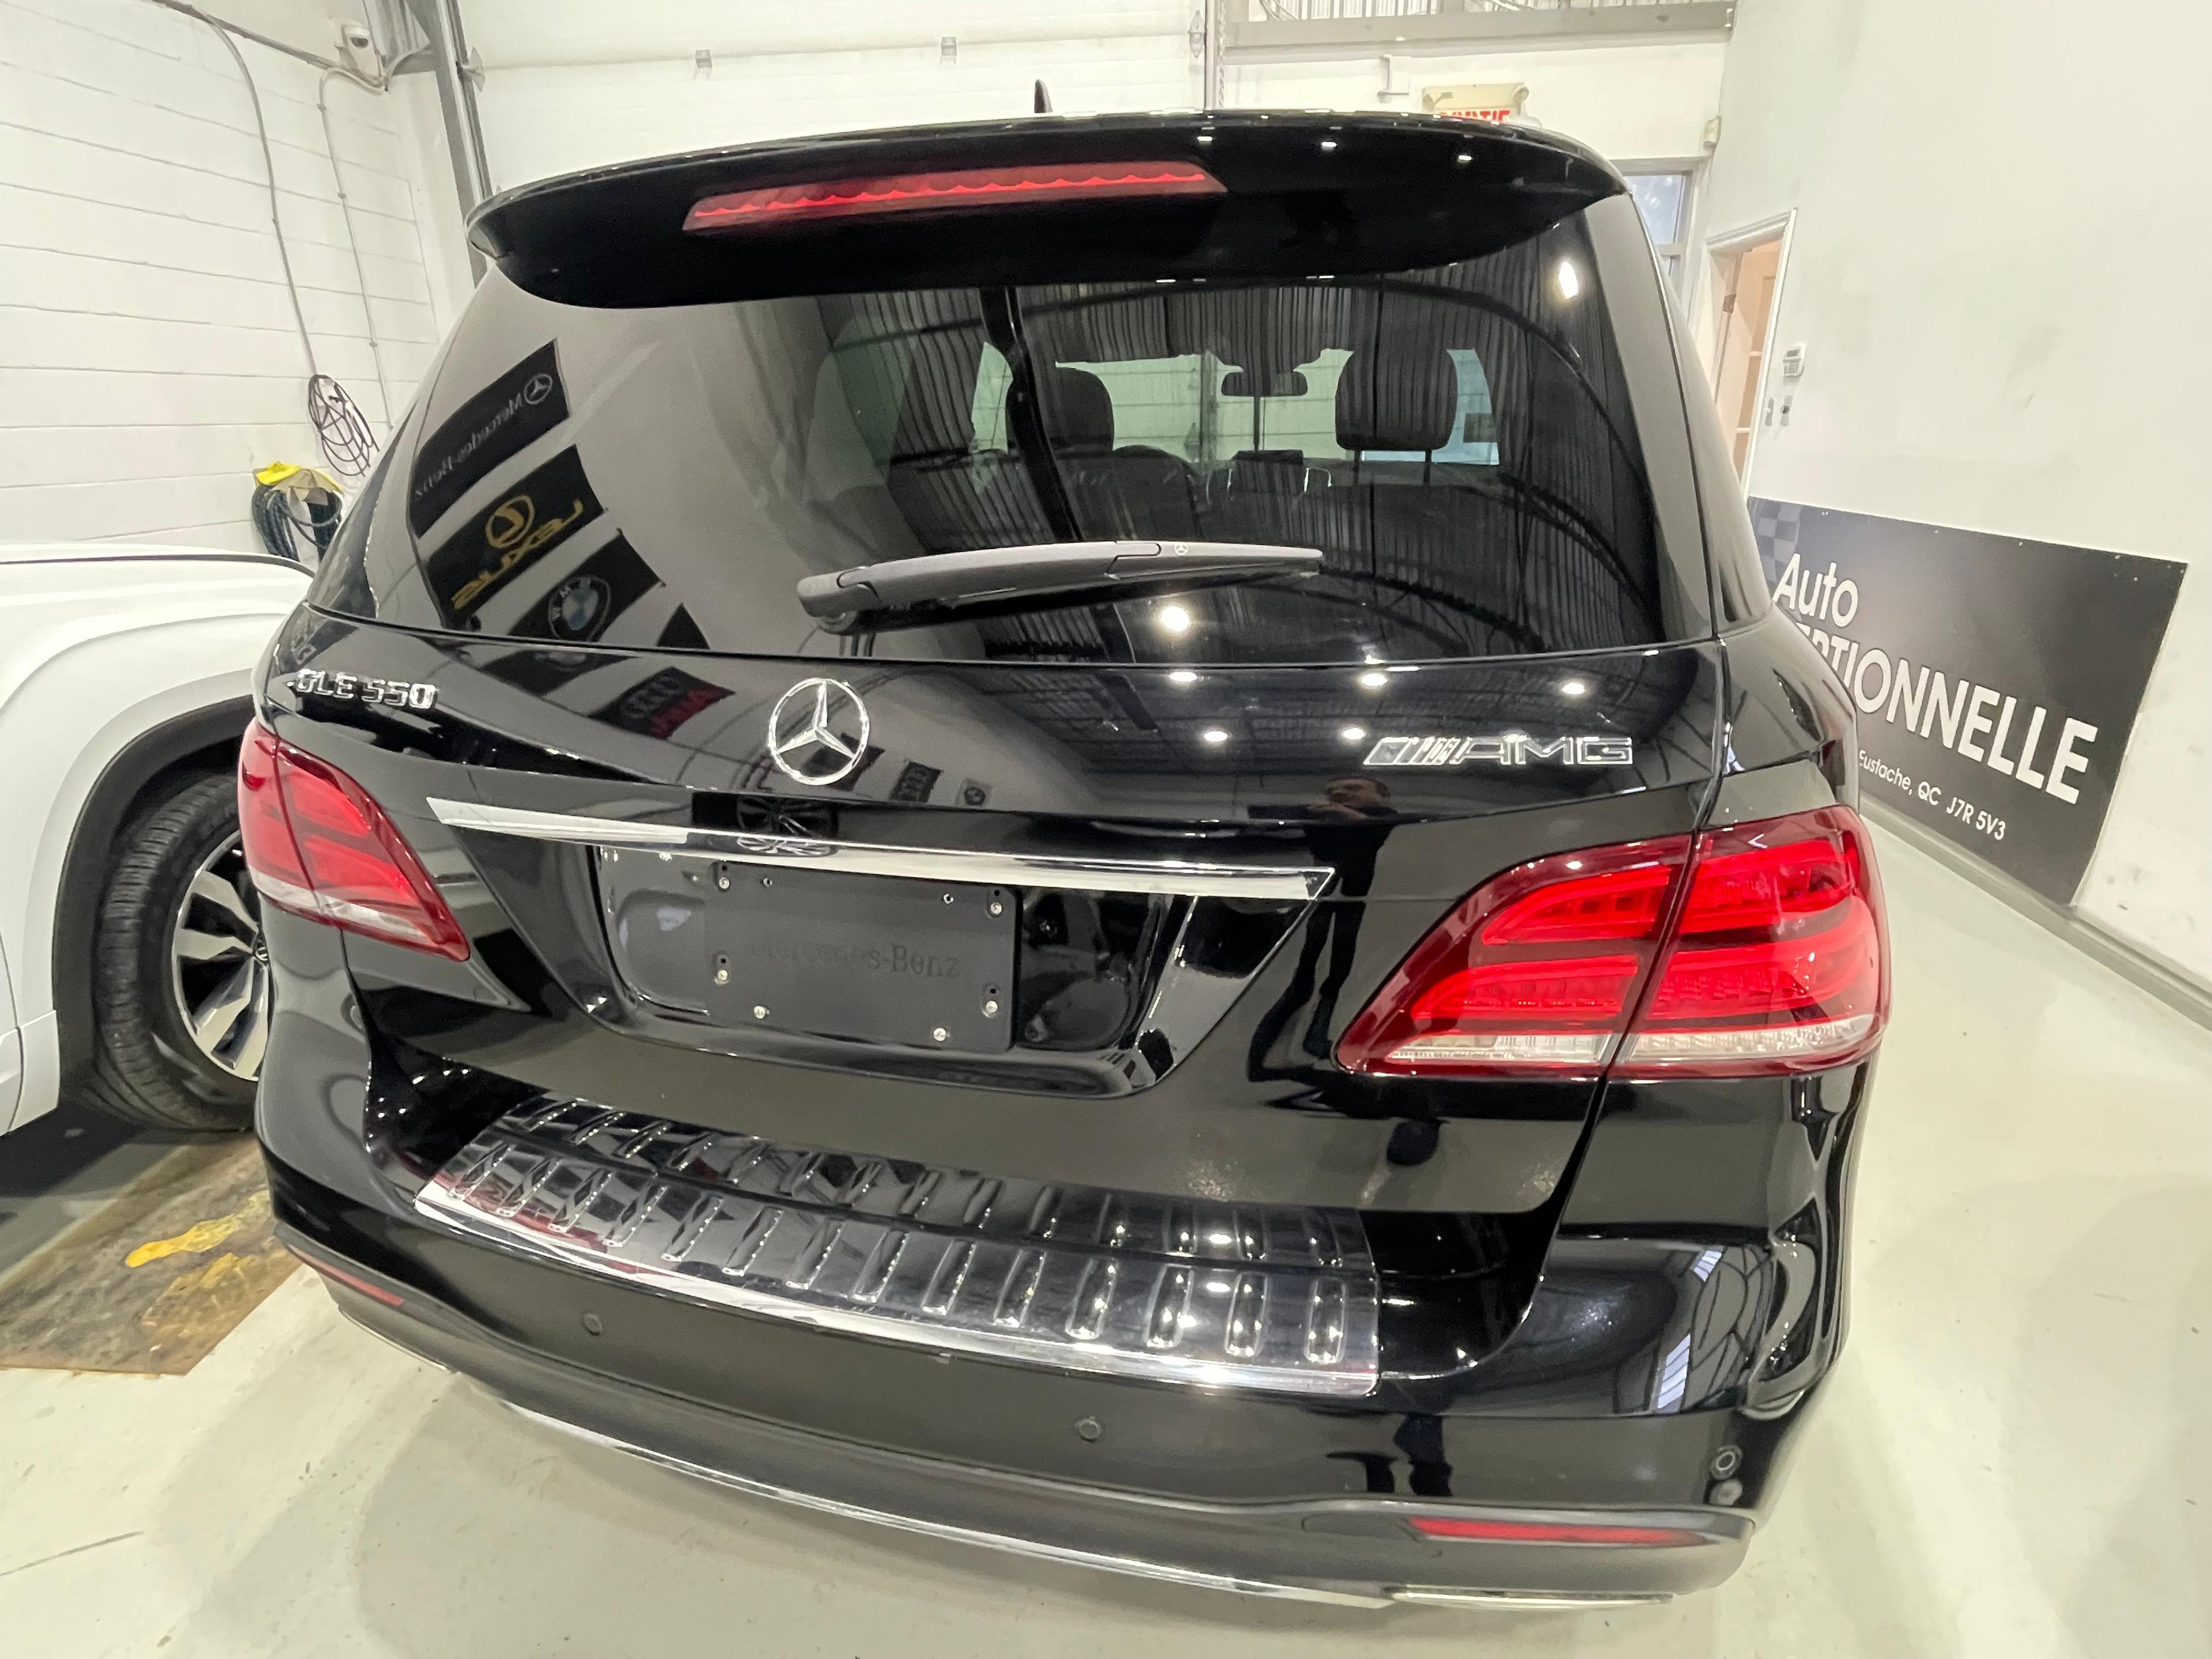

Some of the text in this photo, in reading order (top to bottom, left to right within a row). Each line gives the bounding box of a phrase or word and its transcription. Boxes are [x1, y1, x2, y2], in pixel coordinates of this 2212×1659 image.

[1772, 553, 1858, 627] Auto
[297, 668, 437, 709] GLE 550
[1796, 623, 2098, 804] PTIONNELLE
[1450, 735, 1633, 765] AMG
[1918, 781, 1941, 805] QC
[1946, 797, 1974, 824] J7R
[1976, 810, 2006, 840] 5V3
